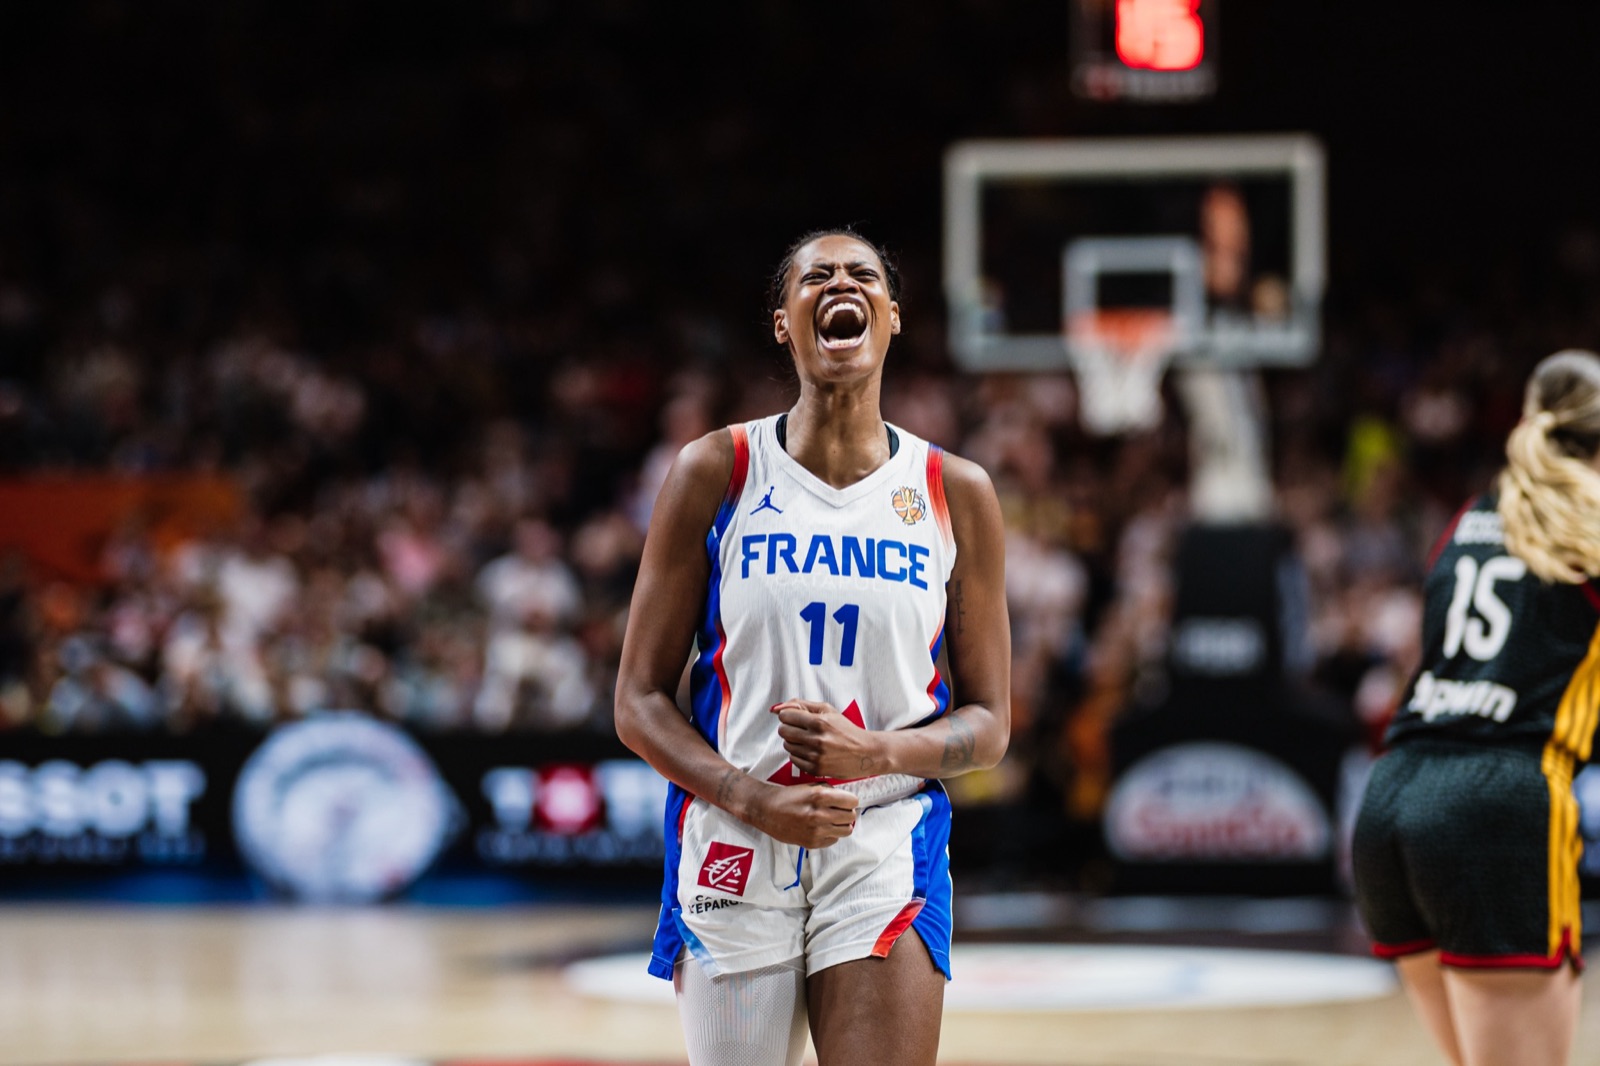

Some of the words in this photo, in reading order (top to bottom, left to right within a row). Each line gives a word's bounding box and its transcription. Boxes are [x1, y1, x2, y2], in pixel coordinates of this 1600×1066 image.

[741, 533, 929, 590] FRANCE
[799, 601, 860, 667] 11
[1443, 555, 1526, 660] 15
